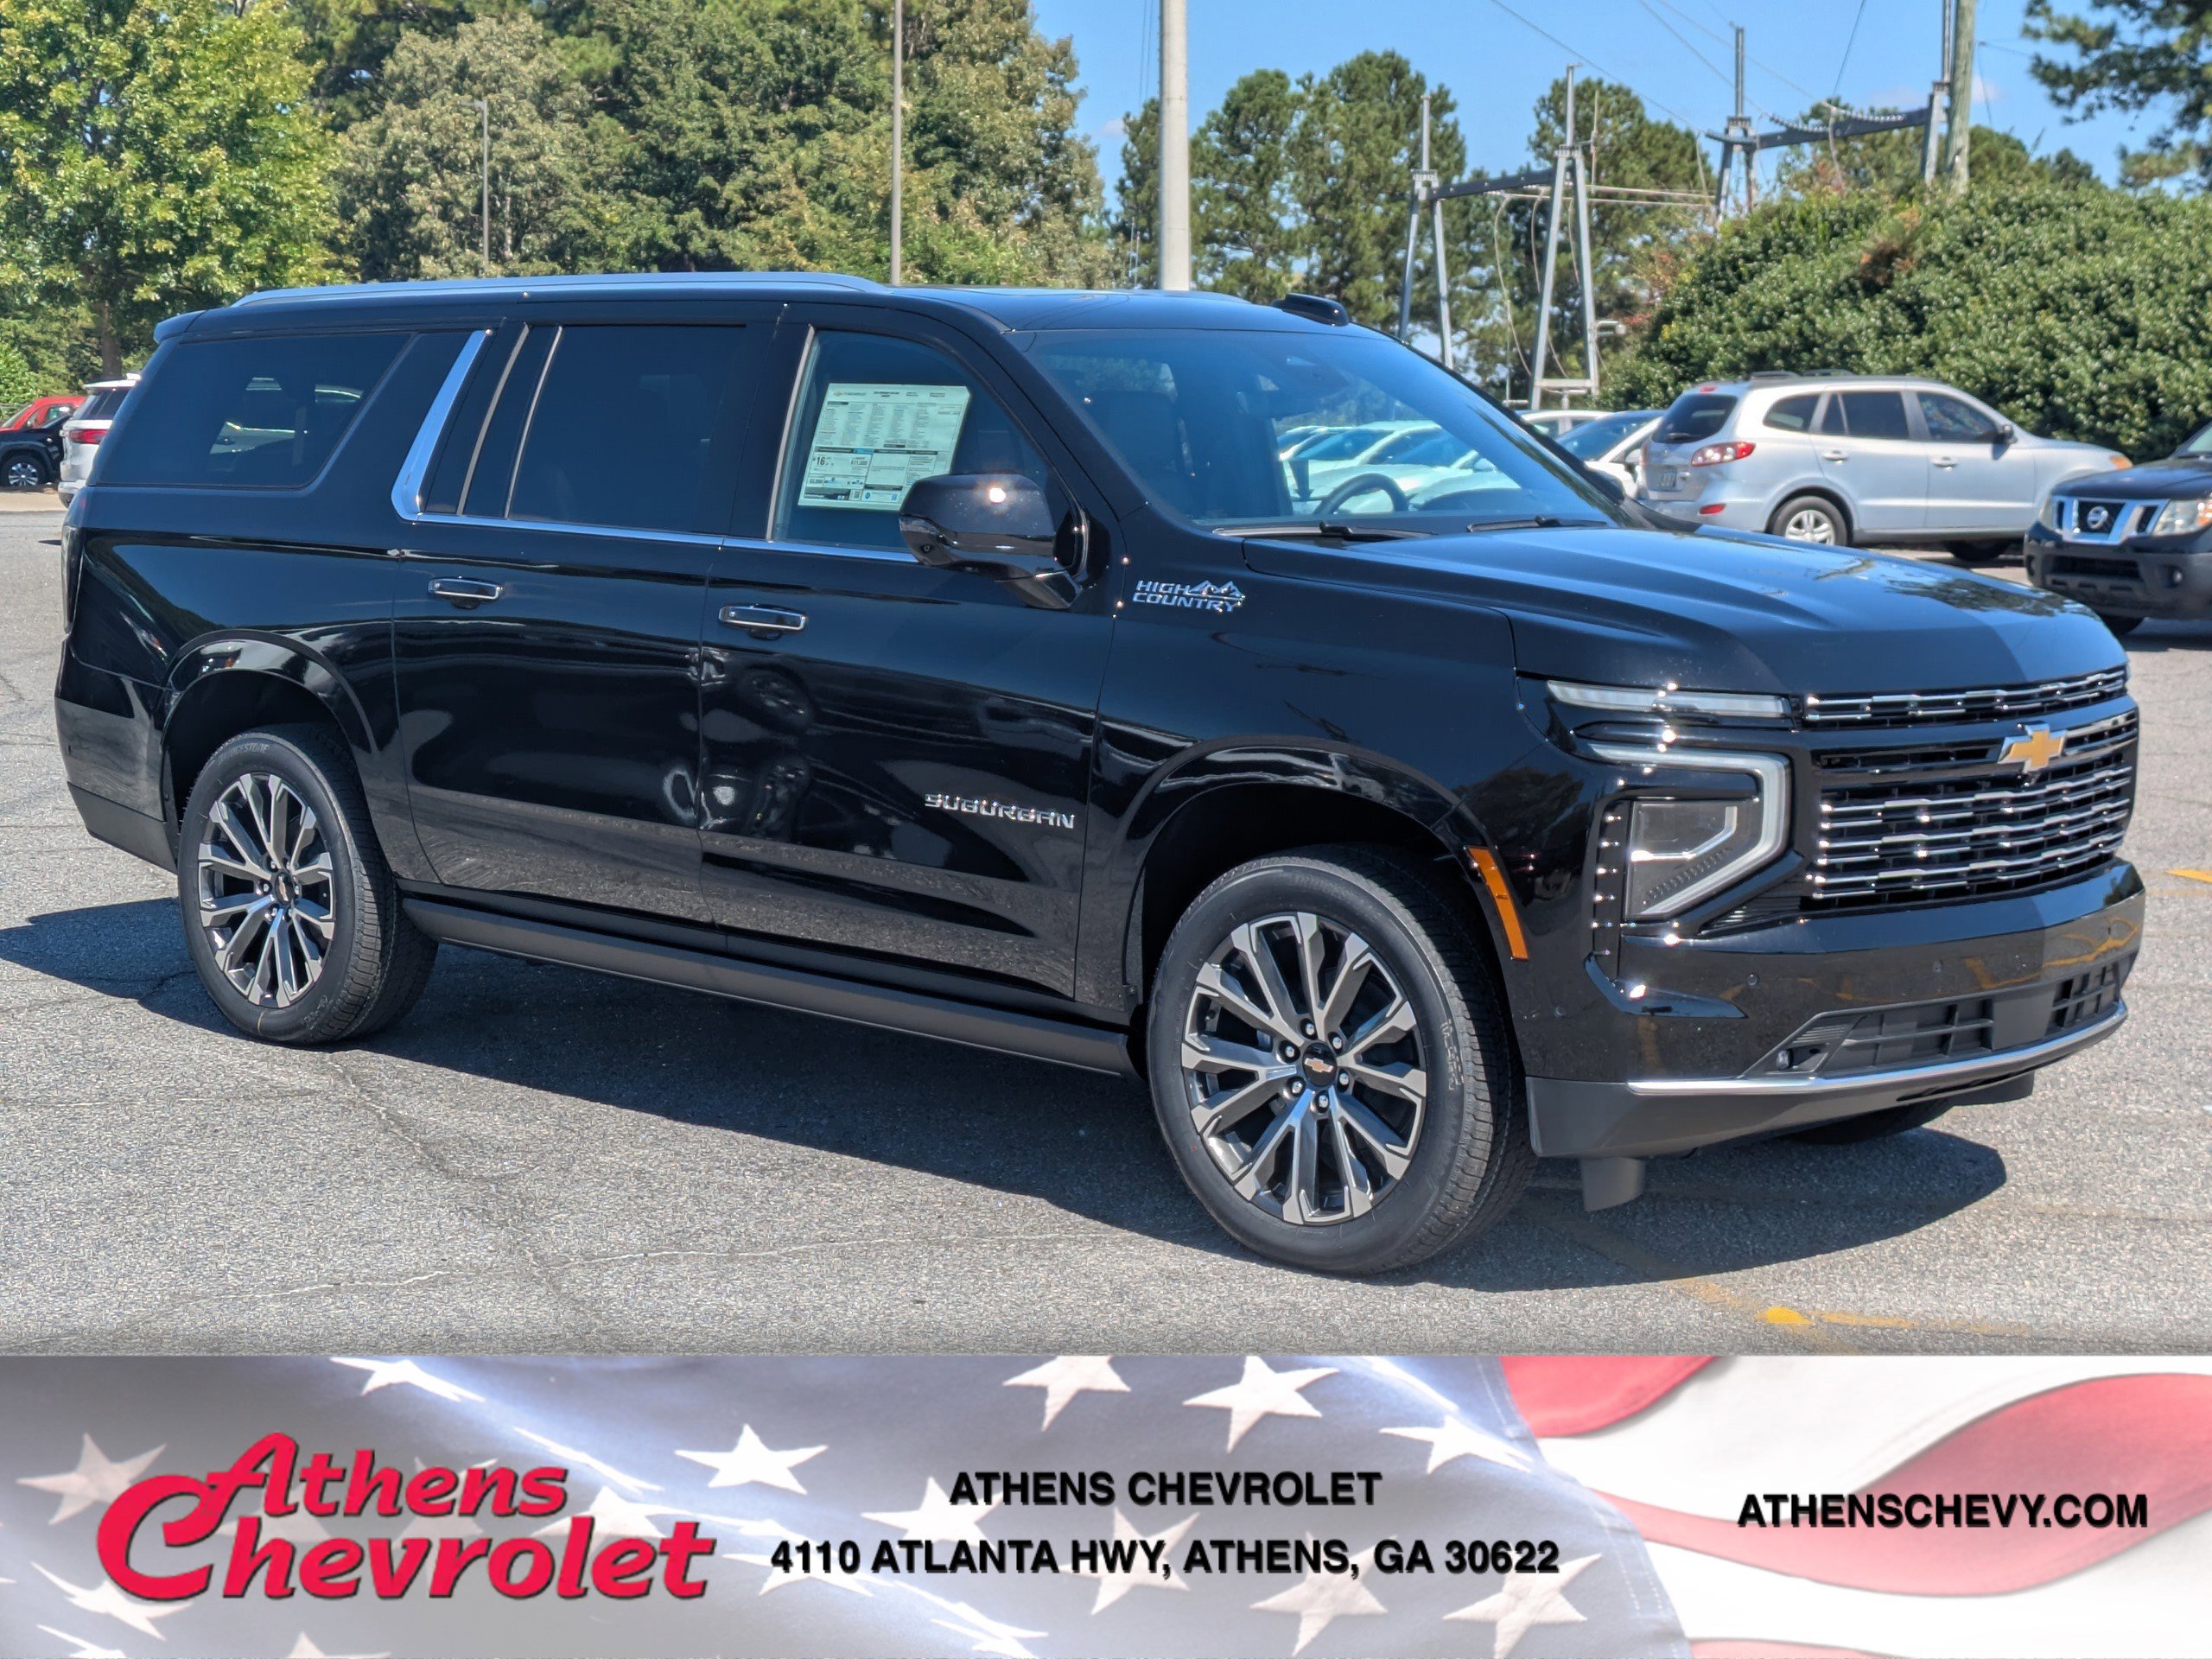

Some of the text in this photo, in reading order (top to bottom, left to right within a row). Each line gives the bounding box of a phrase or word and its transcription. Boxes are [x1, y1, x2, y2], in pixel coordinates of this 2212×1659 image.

[1135, 580, 1191, 595] HIGH
[1132, 592, 1240, 613] COUNTRY
[924, 793, 1075, 830] SUBURBAN
